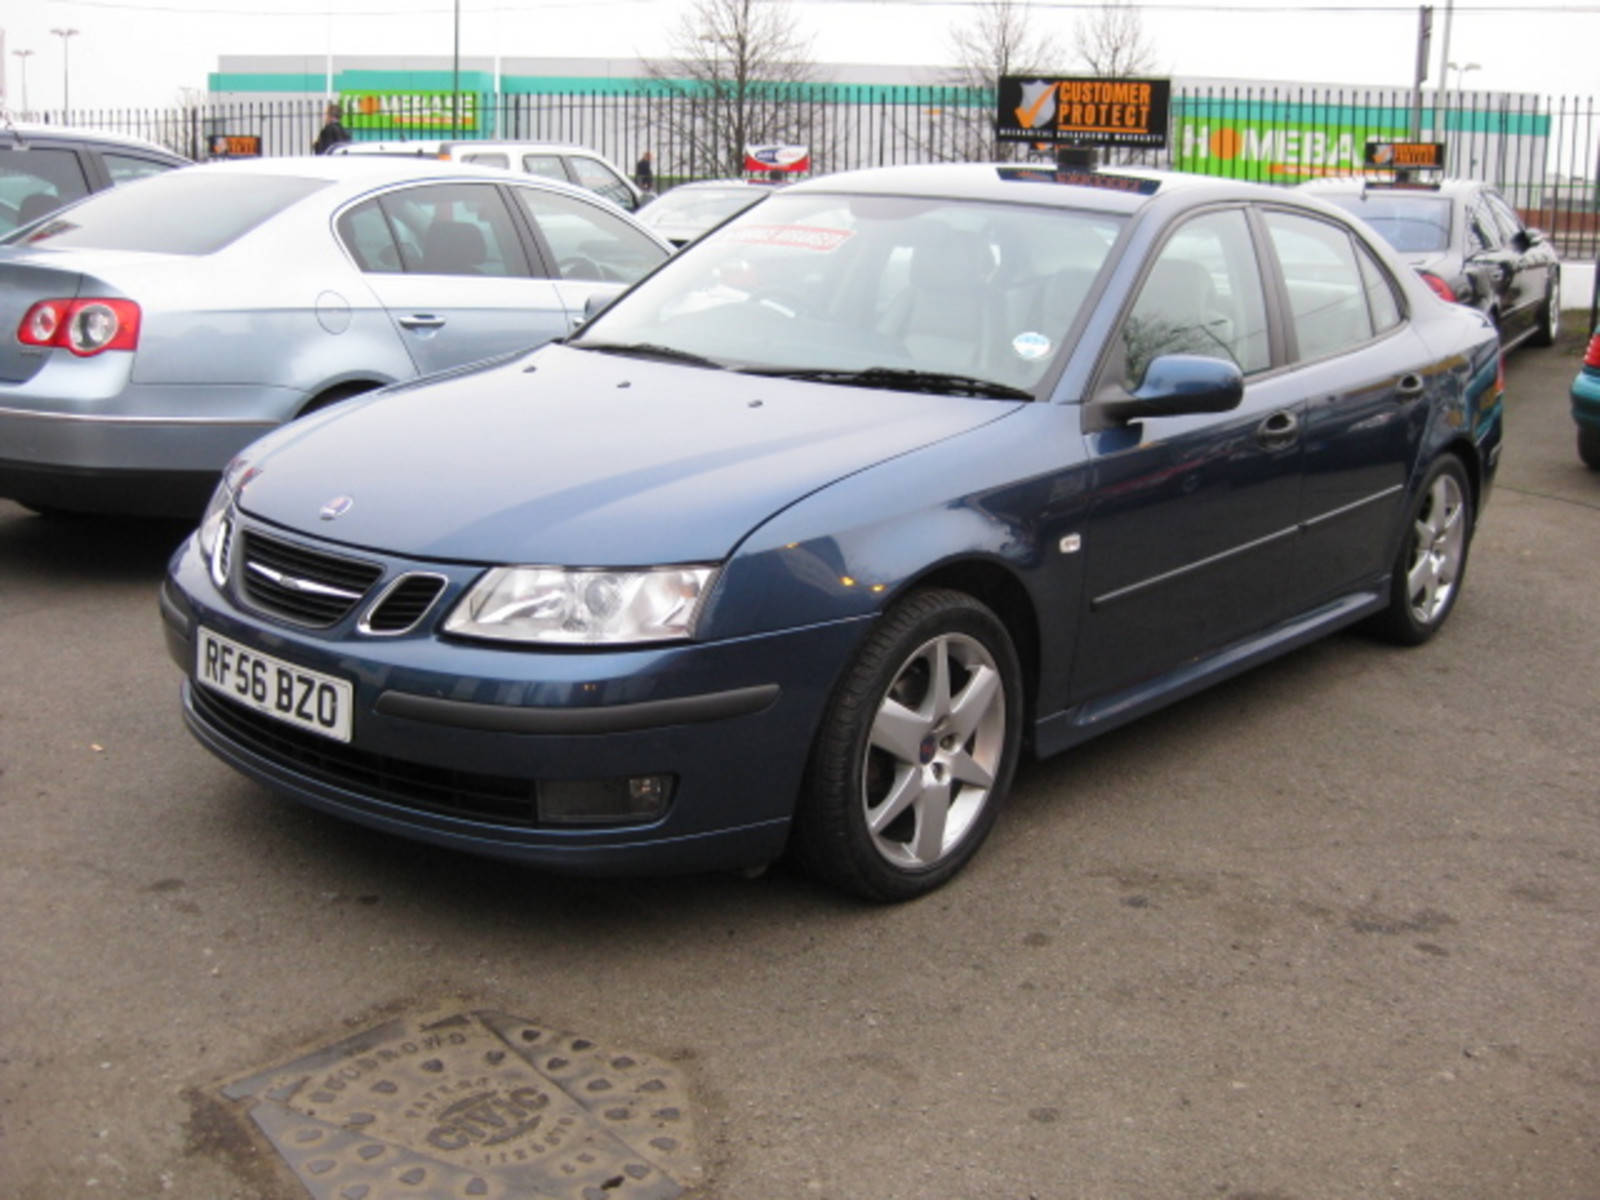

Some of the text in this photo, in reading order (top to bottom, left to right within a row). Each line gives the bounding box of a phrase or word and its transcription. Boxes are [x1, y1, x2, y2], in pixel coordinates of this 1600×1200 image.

[1058, 80, 1152, 104] CUSTOMER
[1058, 103, 1150, 128] PROTECT
[1182, 123, 1411, 168] HOMEBA
[206, 637, 338, 728] RF56 BZO
